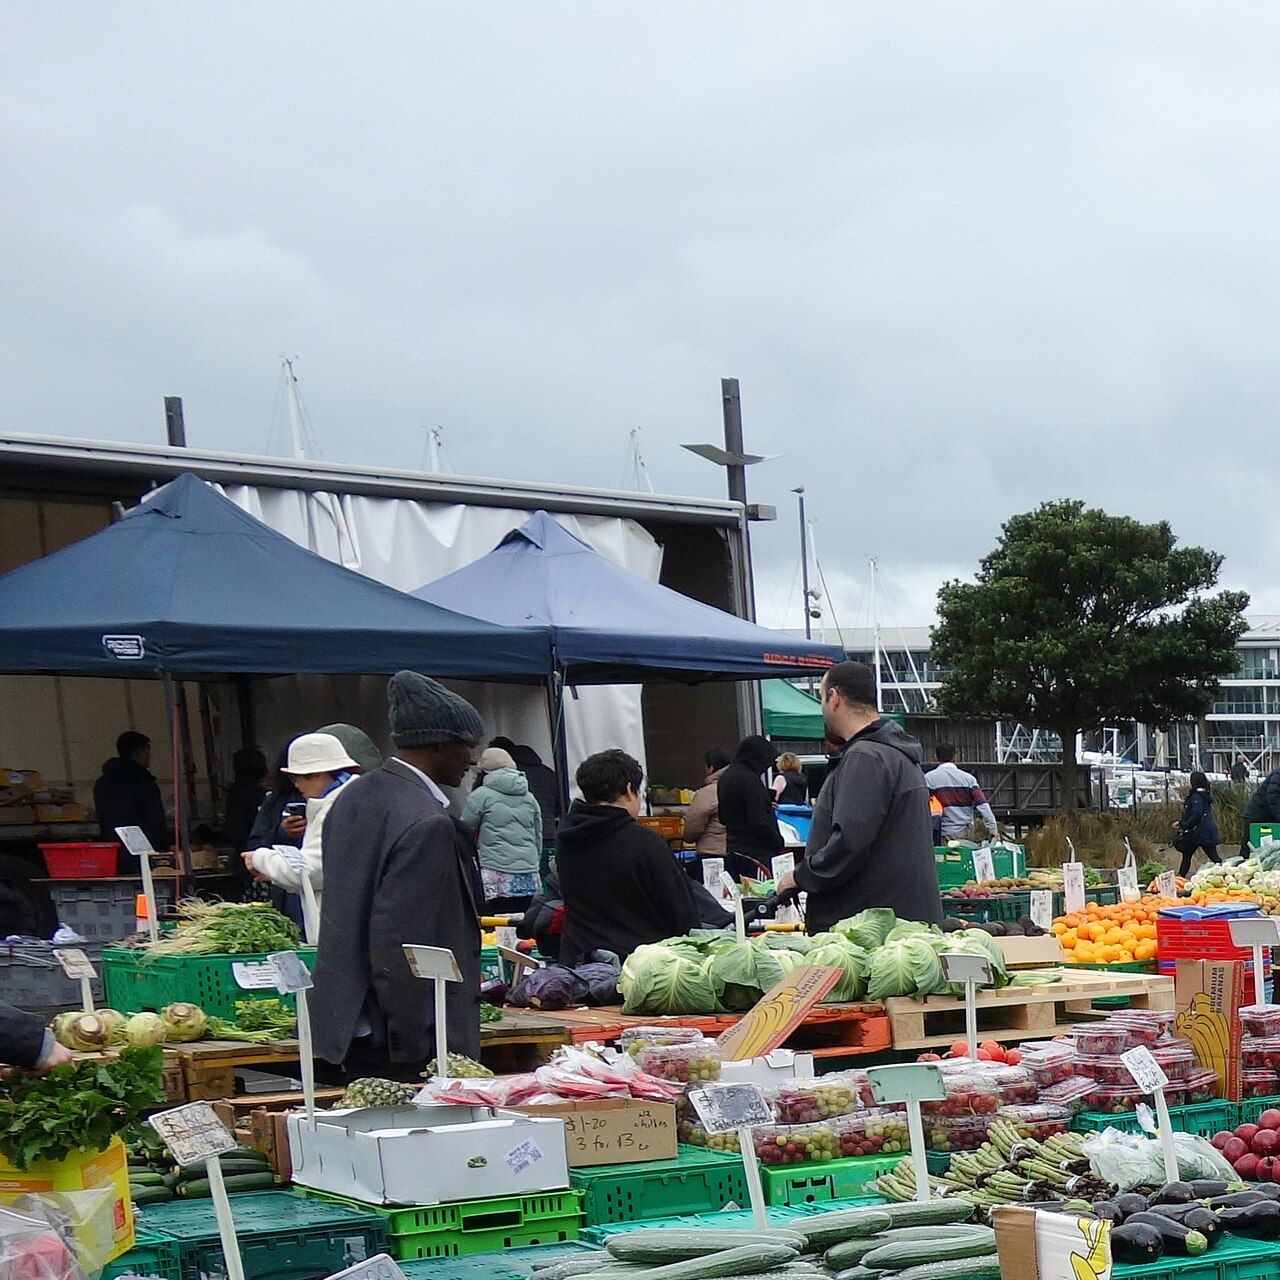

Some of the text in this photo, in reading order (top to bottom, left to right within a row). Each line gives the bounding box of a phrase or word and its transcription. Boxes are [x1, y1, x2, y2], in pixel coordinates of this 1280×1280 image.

[1210, 966, 1218, 1014] PREMIUM
[1216, 966, 1225, 1014] BANANAS
[576, 1136, 587, 1151] 3
[593, 1135, 610, 1151] for
[617, 1133, 635, 1150] $3
